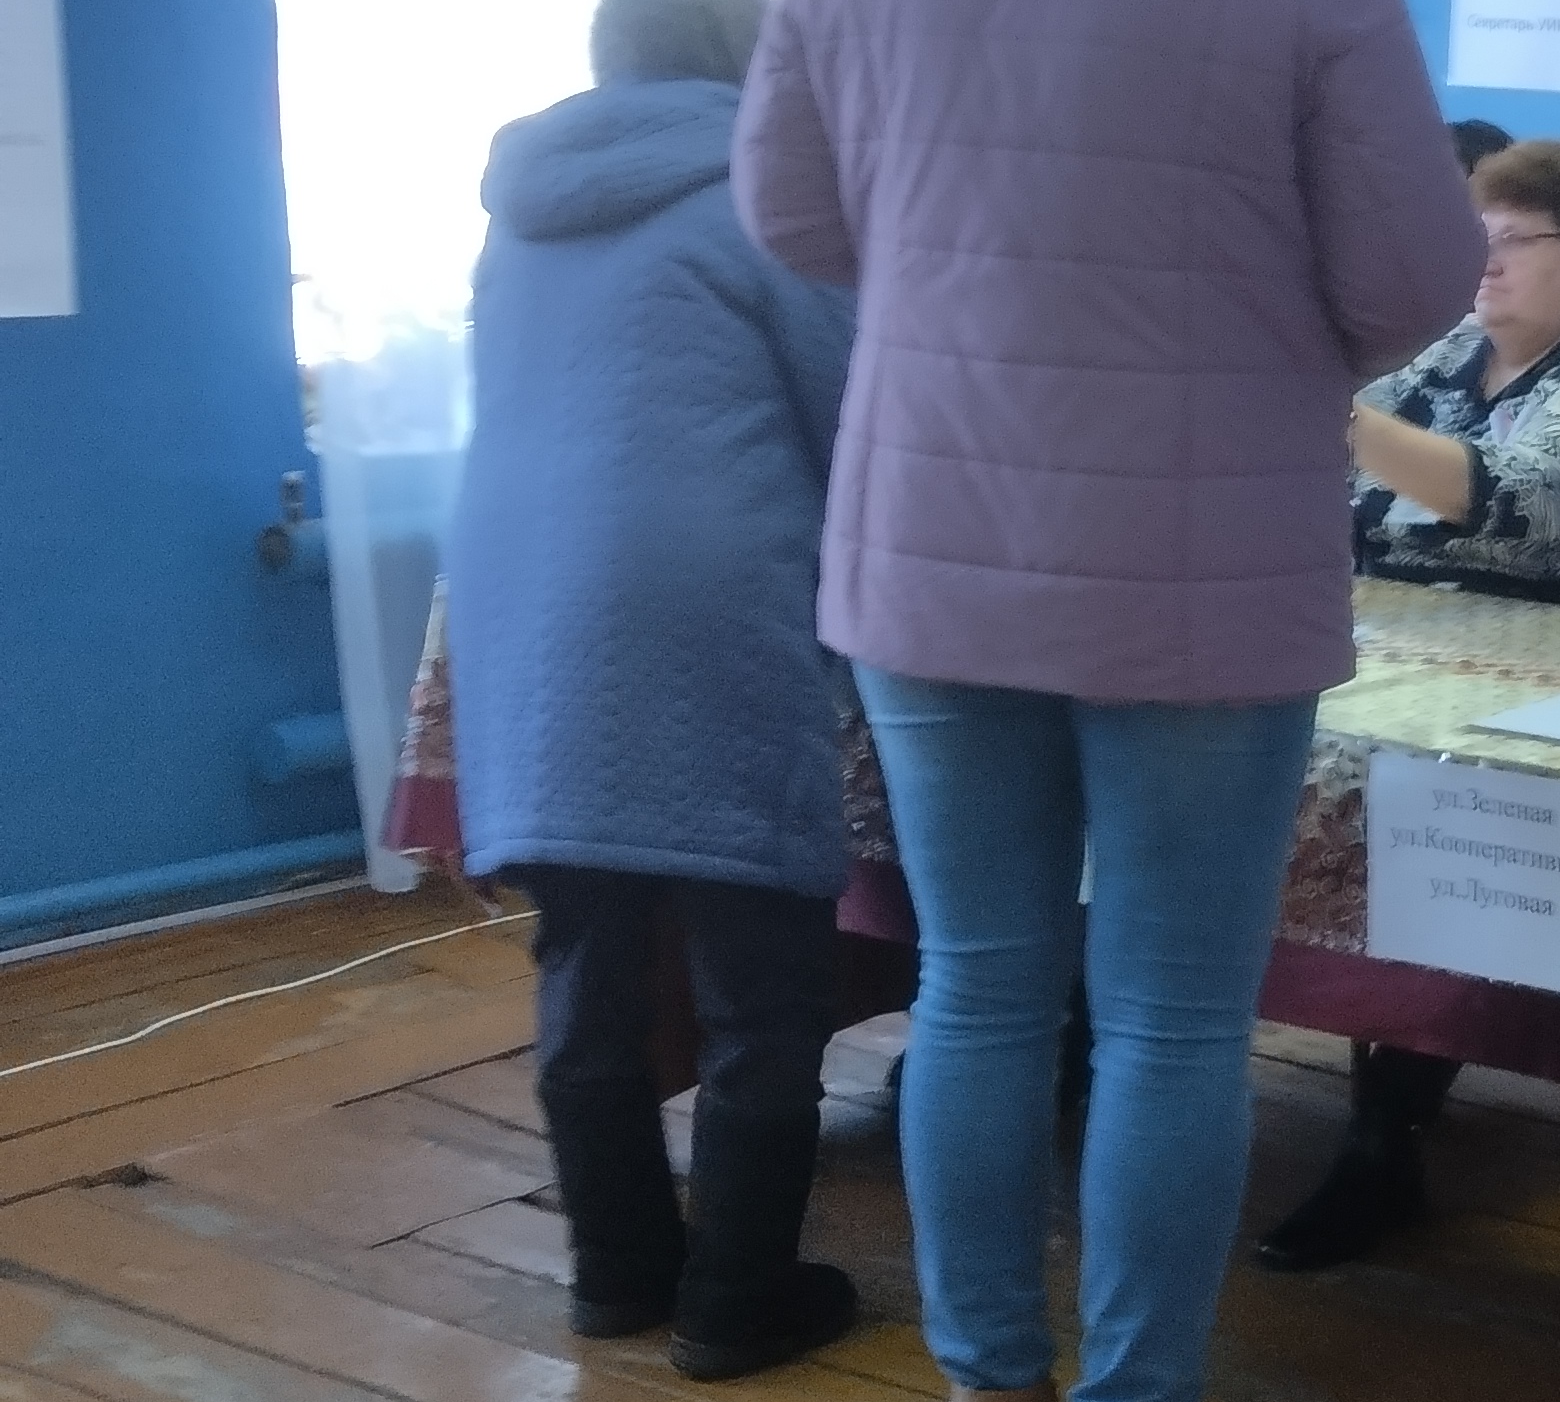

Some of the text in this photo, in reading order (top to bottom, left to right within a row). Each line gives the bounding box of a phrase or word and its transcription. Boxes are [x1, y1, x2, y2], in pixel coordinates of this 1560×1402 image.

[1467, 13, 1534, 33] Секретарь
[1431, 787, 1554, 825] ул.Зеленая
[1429, 876, 1554, 916] ул.Луговая
